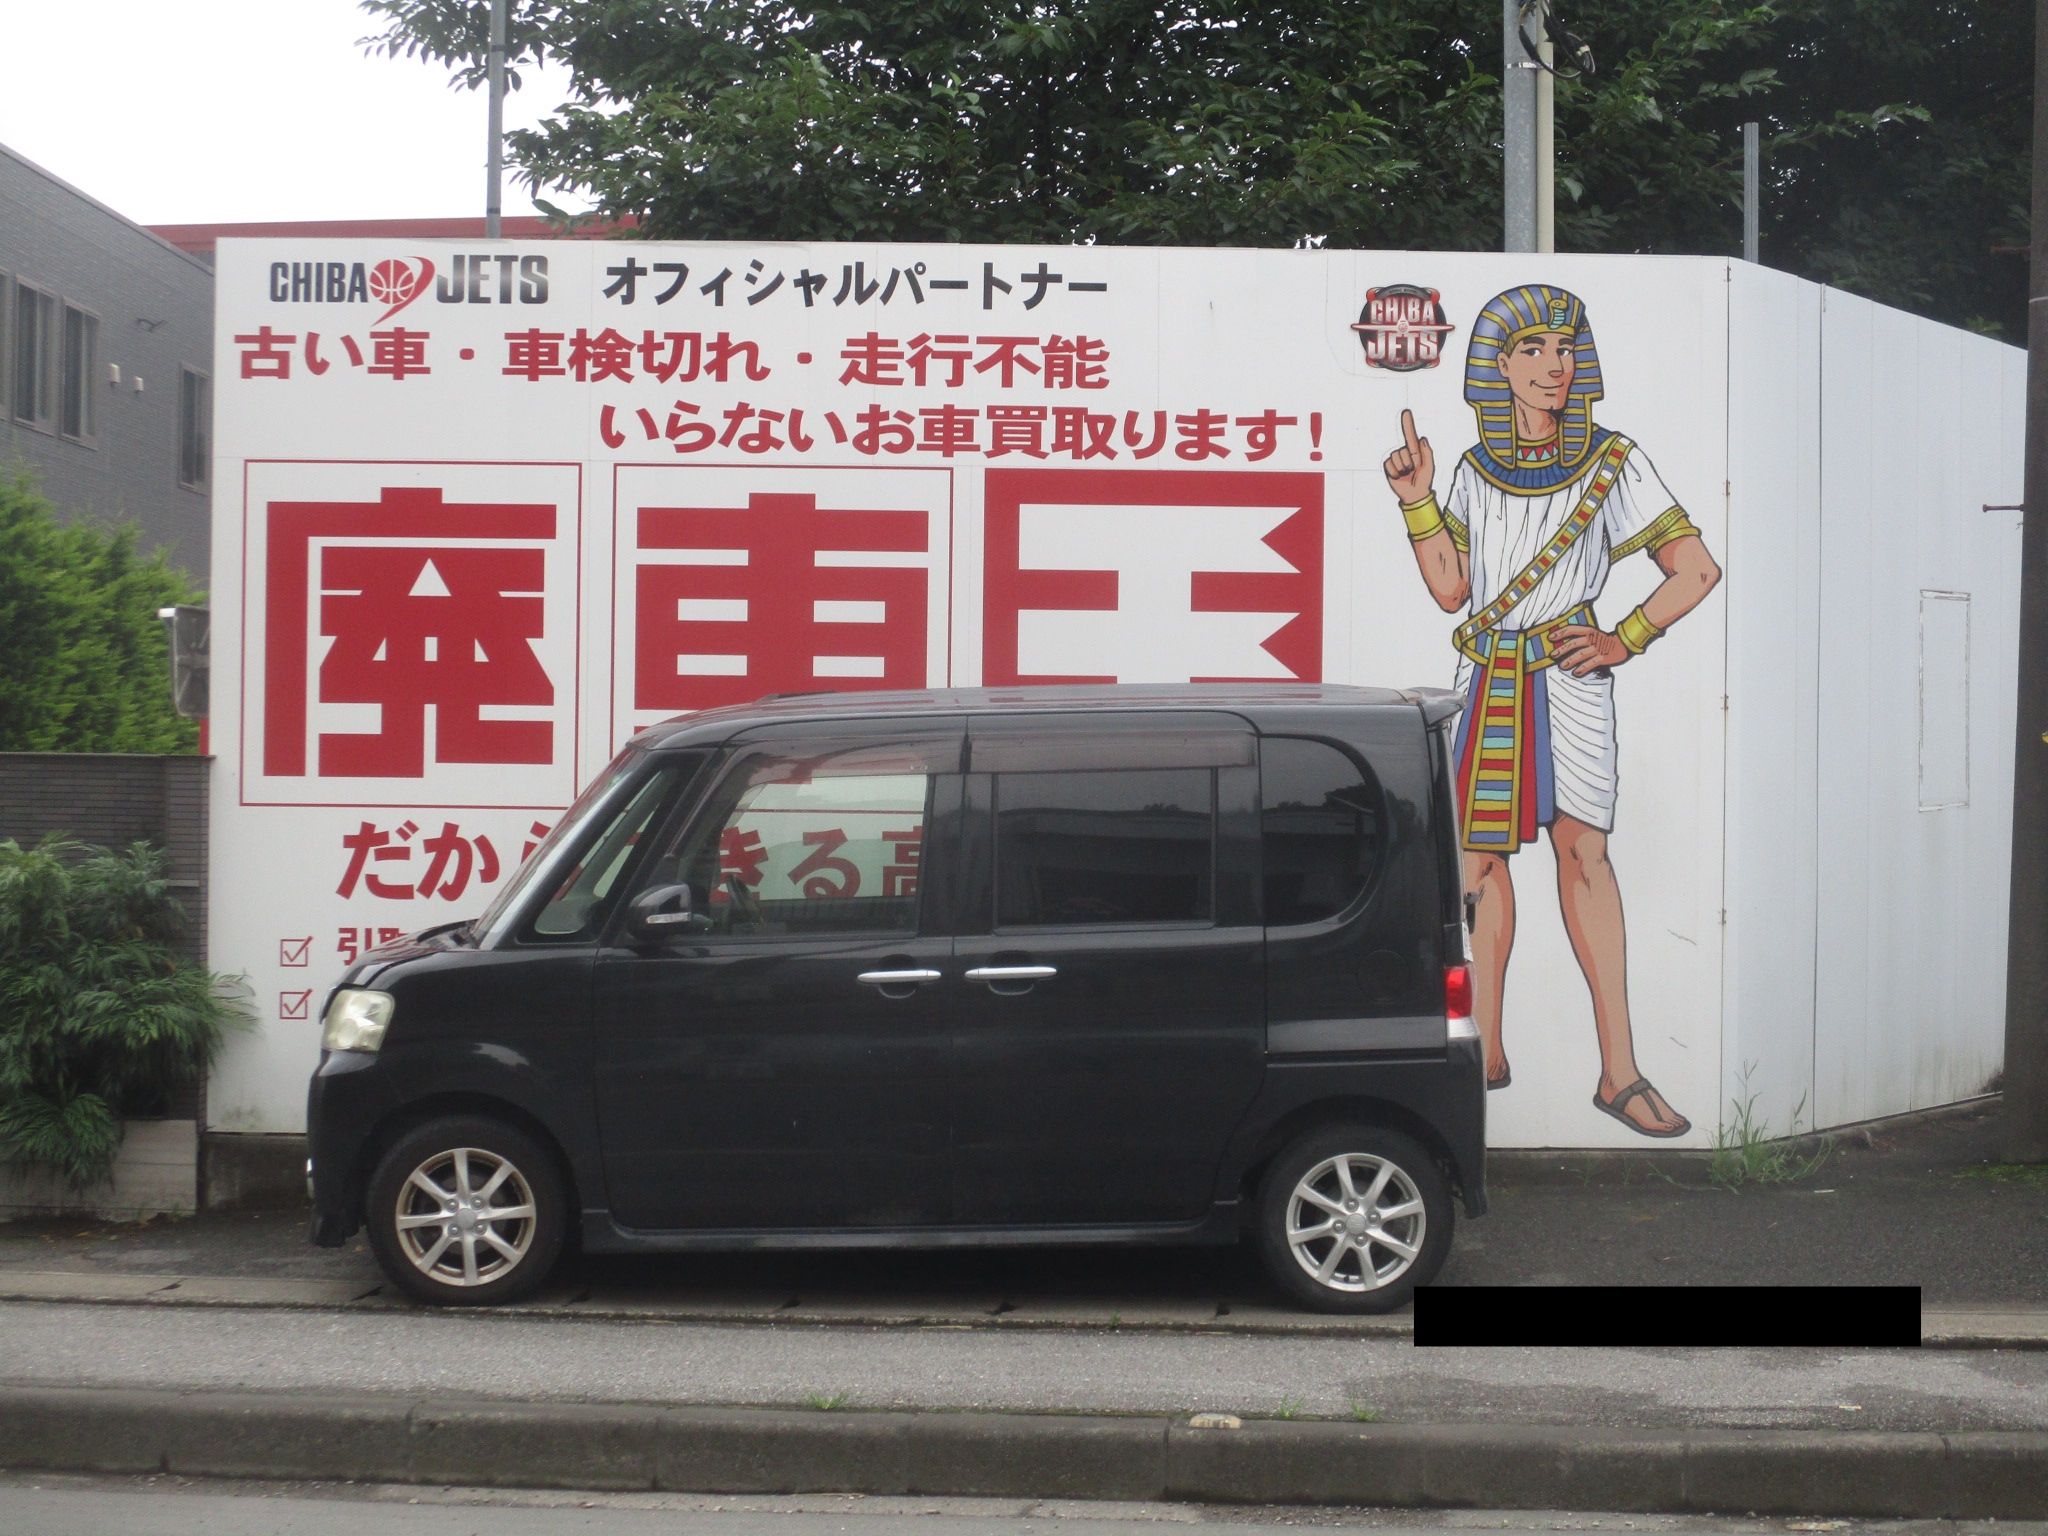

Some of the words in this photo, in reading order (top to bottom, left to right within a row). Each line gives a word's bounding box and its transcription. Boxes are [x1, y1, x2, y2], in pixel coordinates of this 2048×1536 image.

[271, 263, 367, 302] CHIBA
[436, 255, 547, 303] JETS
[603, 258, 1107, 309] オフィシャルパートナー
[1367, 331, 1438, 363] JETS
